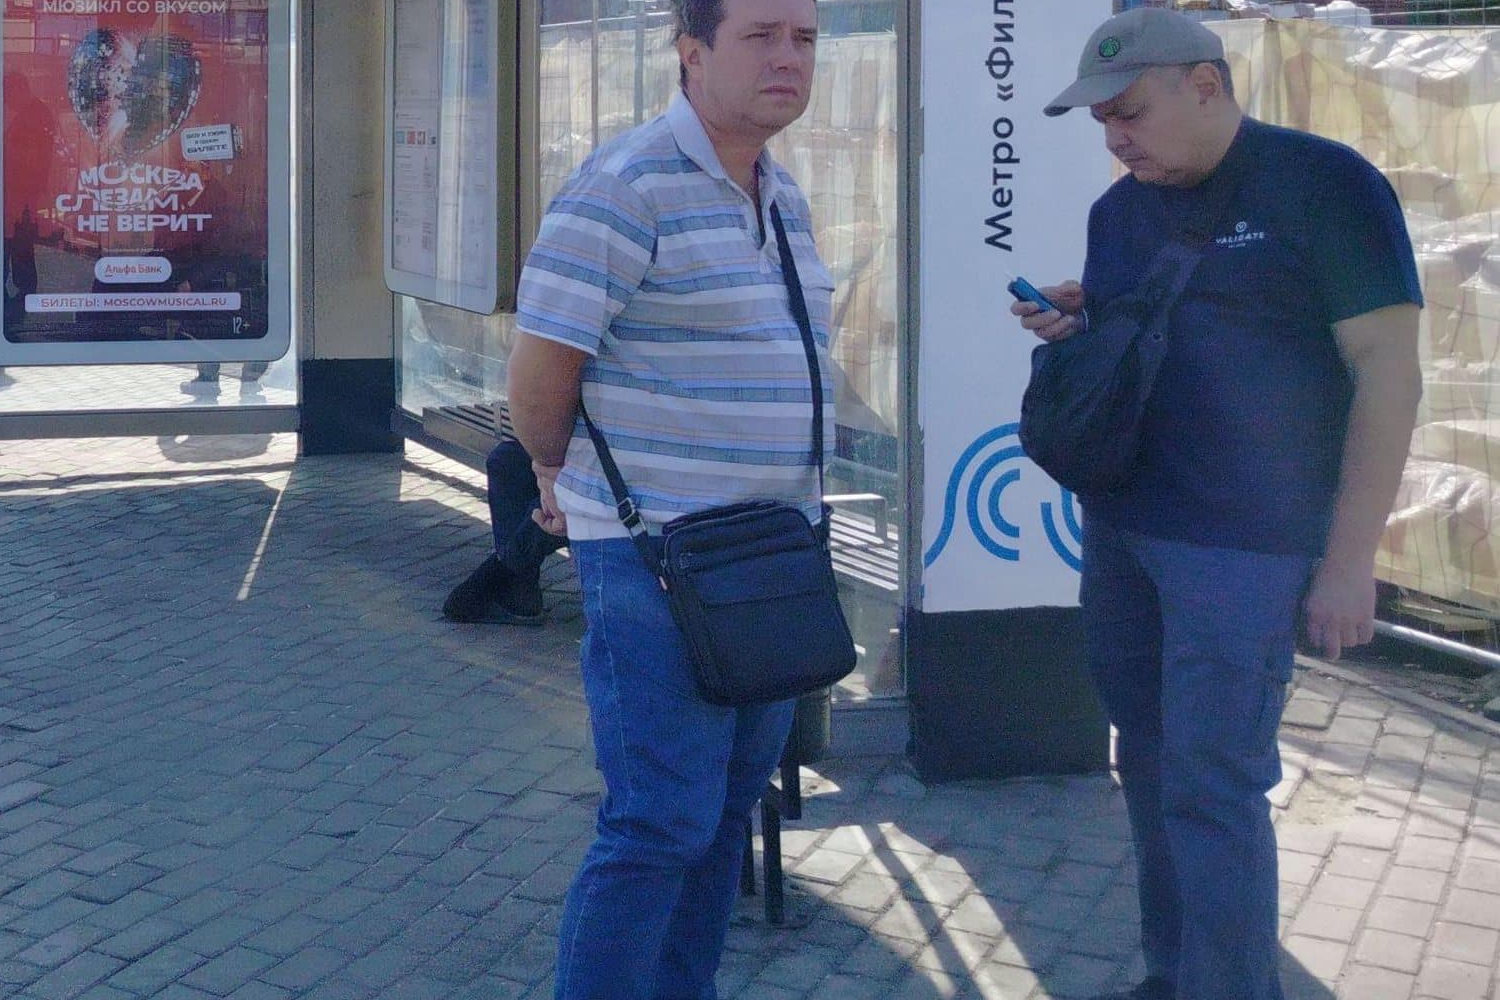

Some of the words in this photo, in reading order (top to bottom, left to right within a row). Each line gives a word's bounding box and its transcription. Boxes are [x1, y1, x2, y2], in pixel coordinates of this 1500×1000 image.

[42, 0, 122, 14] МЮЗИКЛ
[126, 0, 150, 14] СО
[154, 0, 228, 14] ВКУСОМ
[77, 160, 205, 192] МОСКВА
[984, 116, 1021, 252] Метро
[77, 213, 110, 233] НЕ
[116, 213, 213, 233] ВЕРИТ
[138, 263, 163, 275] Банк
[40, 298, 100, 308] БИЛЕТЫ:
[103, 296, 228, 308] MOSCOWMUSICAL.RU
